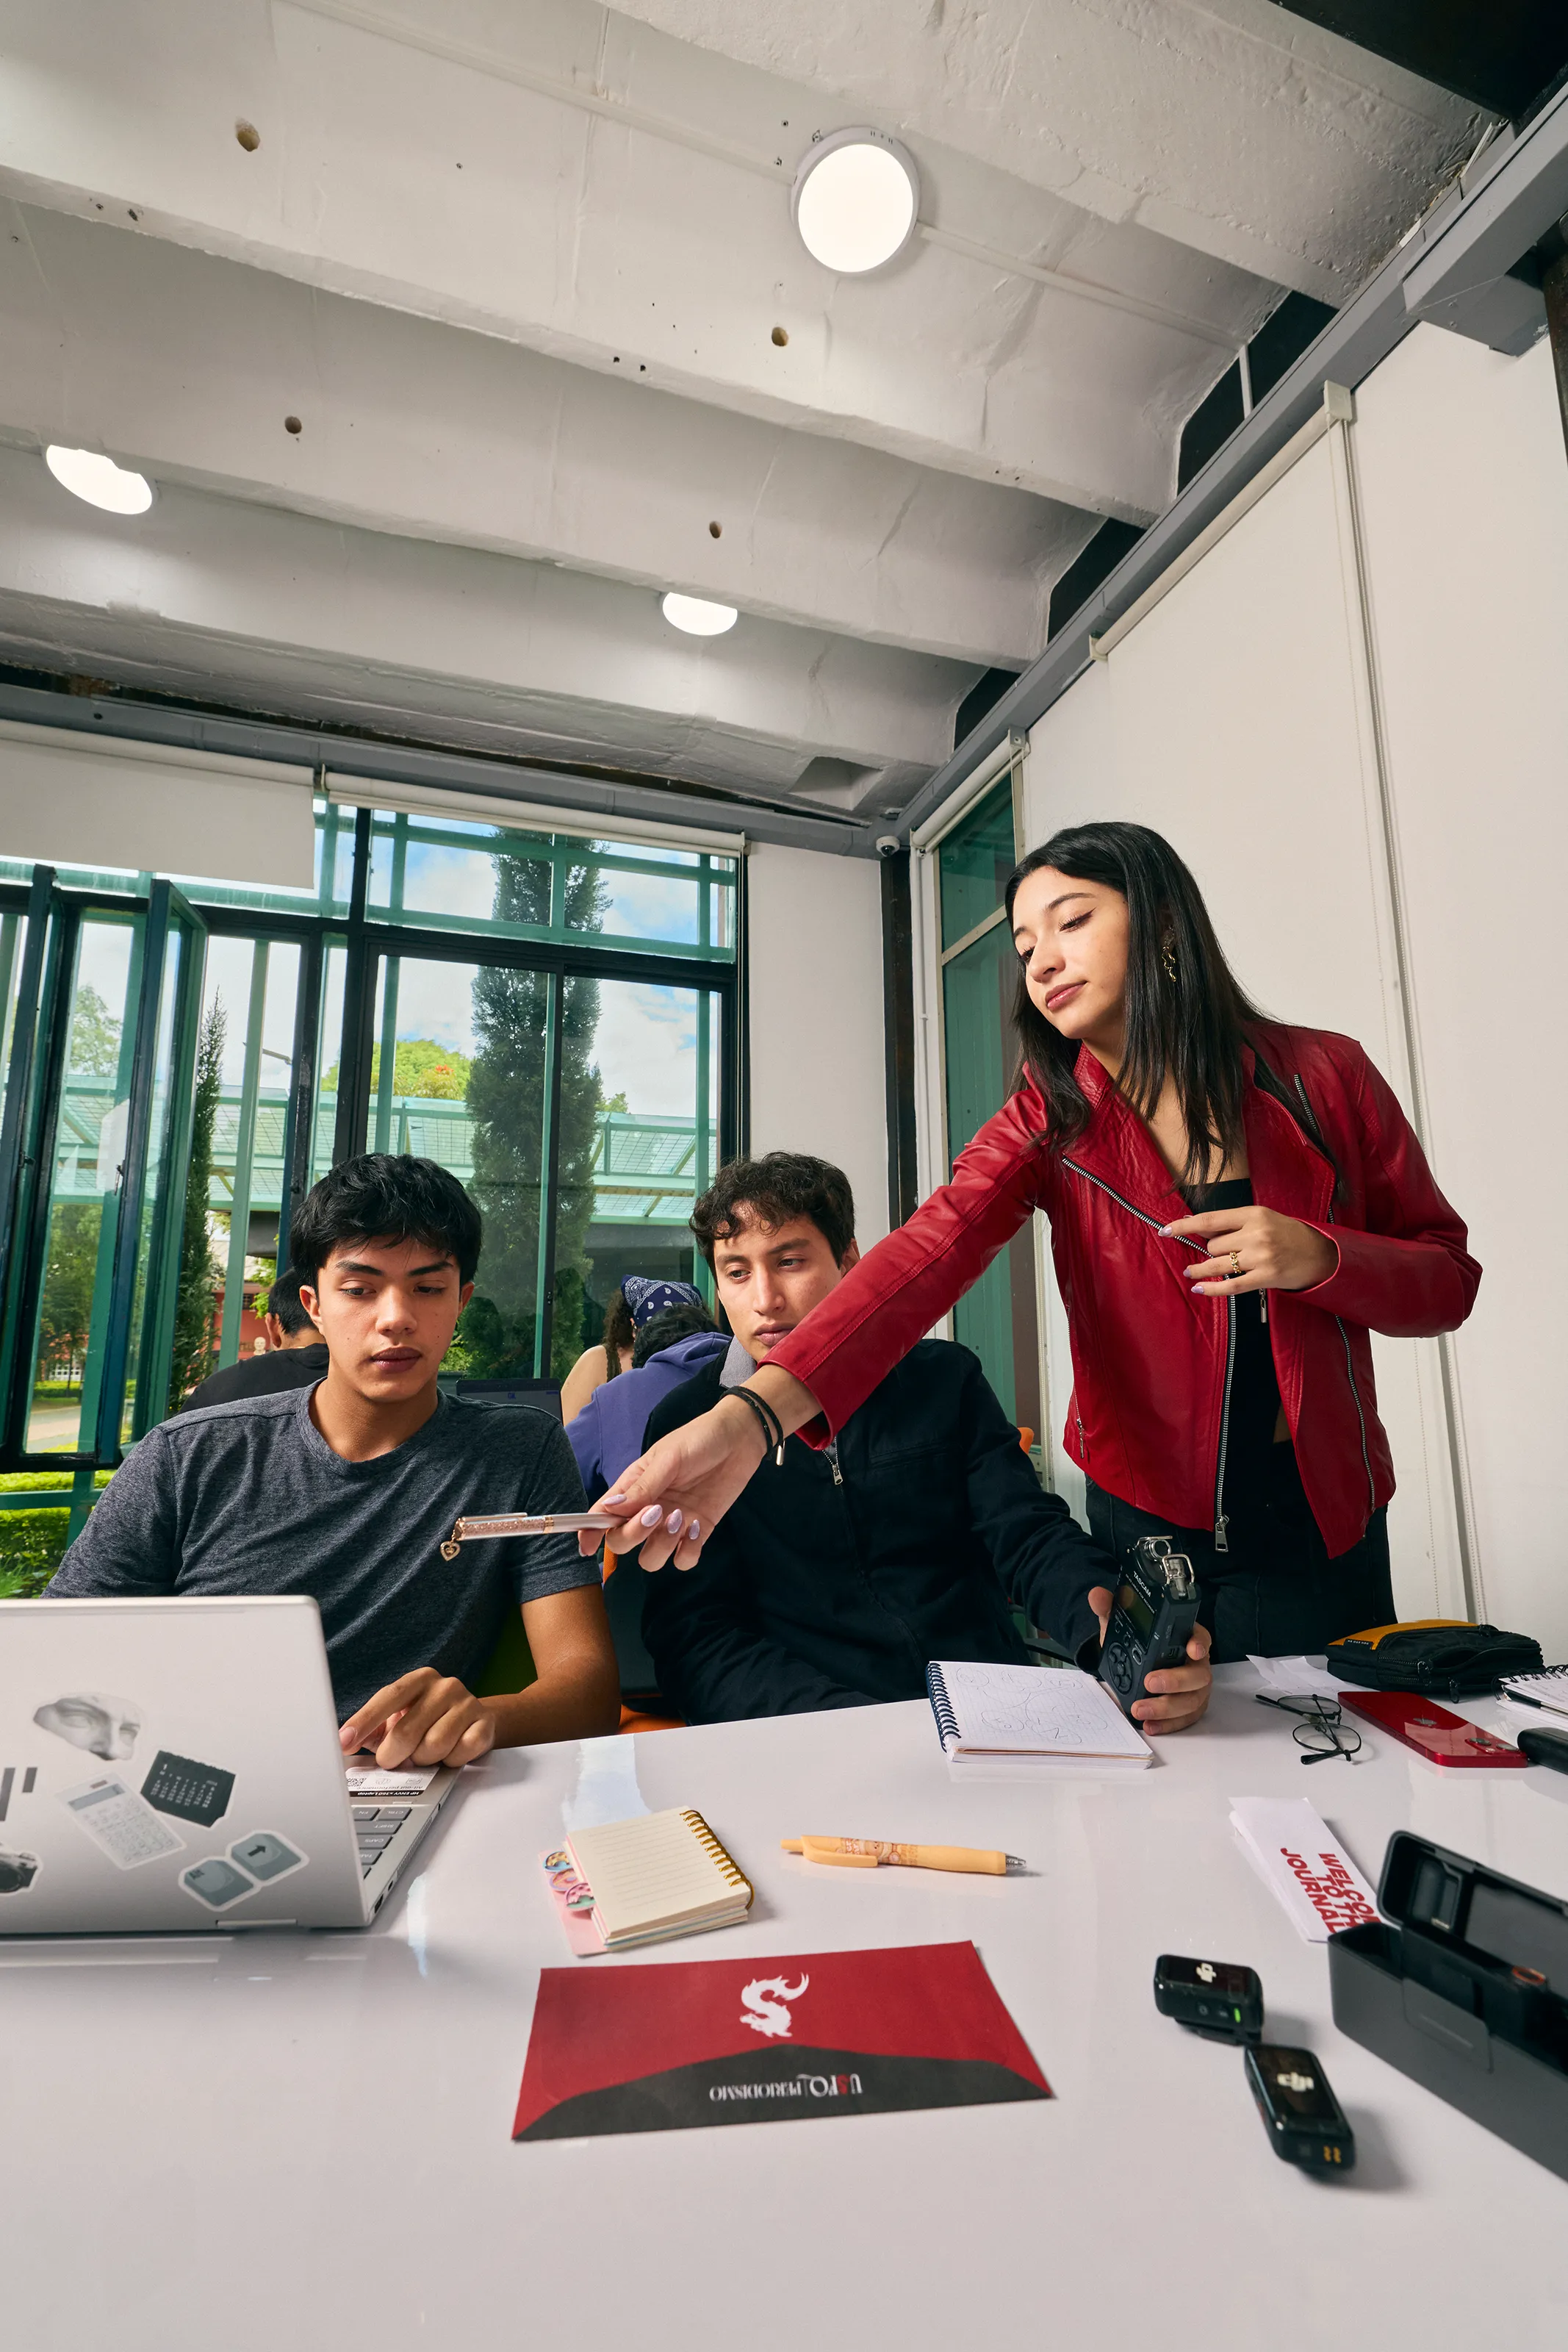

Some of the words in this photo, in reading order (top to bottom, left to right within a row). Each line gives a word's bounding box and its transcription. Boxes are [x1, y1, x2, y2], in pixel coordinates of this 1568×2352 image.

[1133, 1571, 1151, 1597] TASCAM
[1315, 1874, 1345, 1899] TO
[709, 2081, 802, 2102] PERIODISMO
[796, 2073, 863, 2098] USFQ
